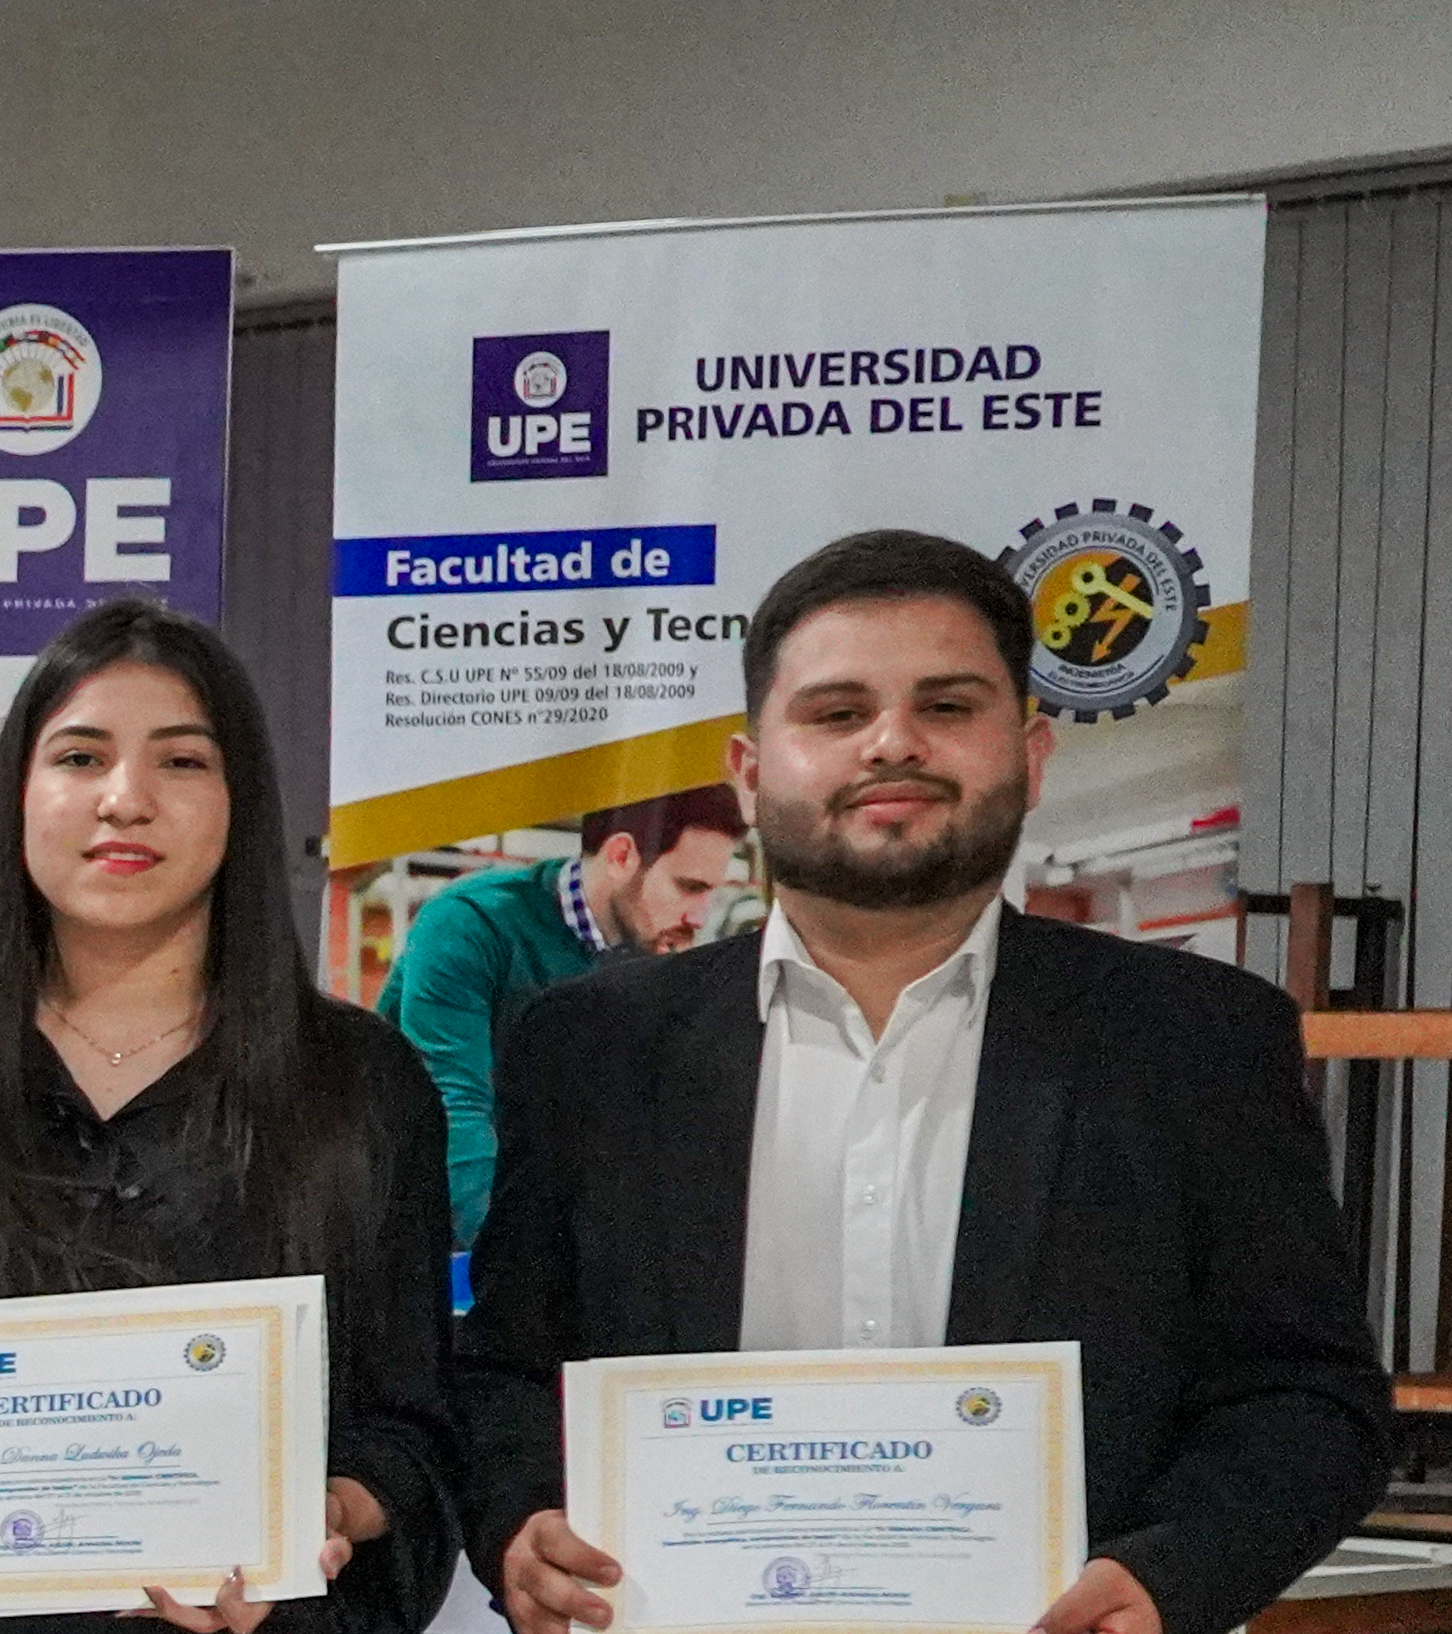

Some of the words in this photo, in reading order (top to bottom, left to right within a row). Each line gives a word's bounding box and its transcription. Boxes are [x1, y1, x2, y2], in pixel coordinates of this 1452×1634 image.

[696, 344, 1042, 393] UNIVERSIDAD
[636, 399, 852, 443] PRIVADA
[869, 396, 963, 434] DEL
[981, 390, 1103, 431] ESTE
[487, 411, 592, 457] UPE
[1083, 531, 1145, 551] PRIVADA
[386, 541, 593, 587] Facultad
[610, 538, 671, 579] de
[387, 610, 585, 649] Ciencias
[602, 616, 631, 653] y
[646, 607, 748, 642] Tecn
[465, 667, 492, 683] UPE
[573, 664, 597, 679] del
[688, 666, 698, 680] y
[420, 690, 495, 705] Directorio
[500, 688, 530, 703] UPE
[585, 685, 609, 701] del
[385, 711, 466, 728] Resolución
[471, 709, 523, 726] CONES
[700, 1397, 773, 1422] UPE
[726, 1440, 933, 1463] CERTIFICADO
